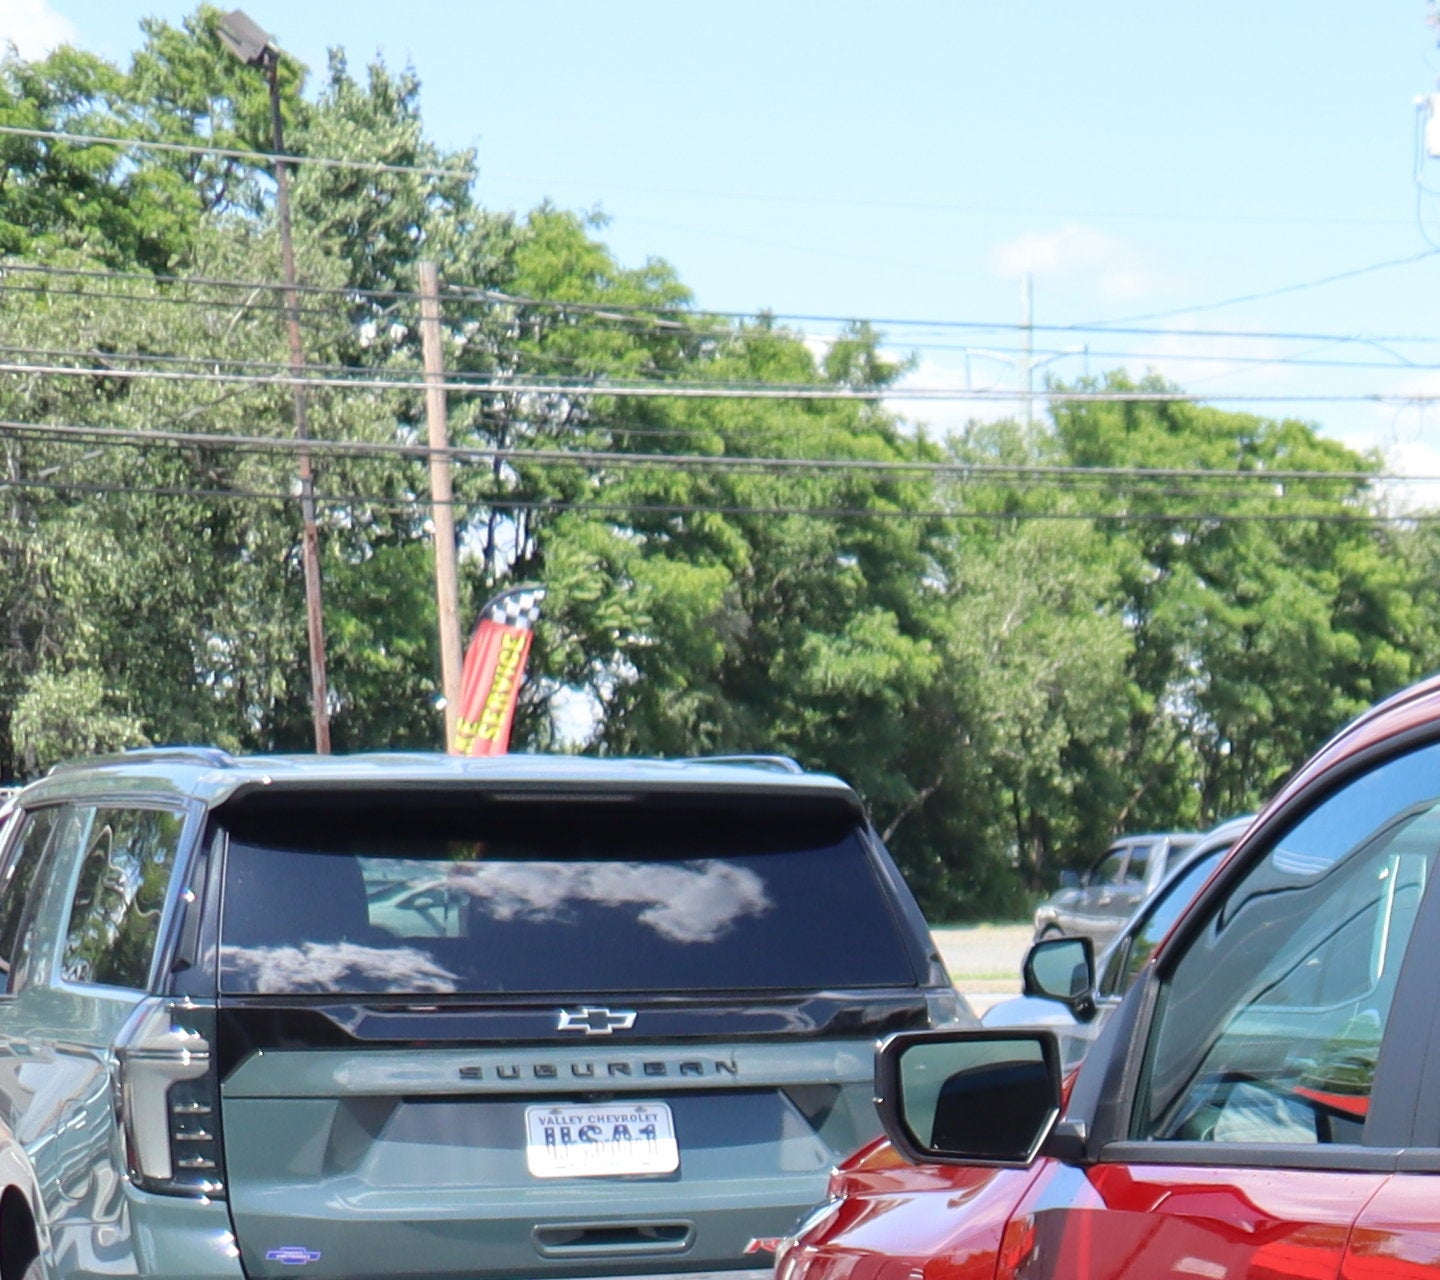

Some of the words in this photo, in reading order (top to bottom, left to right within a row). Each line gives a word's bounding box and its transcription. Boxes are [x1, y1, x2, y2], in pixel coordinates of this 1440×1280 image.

[459, 1060, 740, 1081] SUBURBAN
[539, 1114, 585, 1126] VALLEY
[588, 1112, 659, 1125] CHEVROLET
